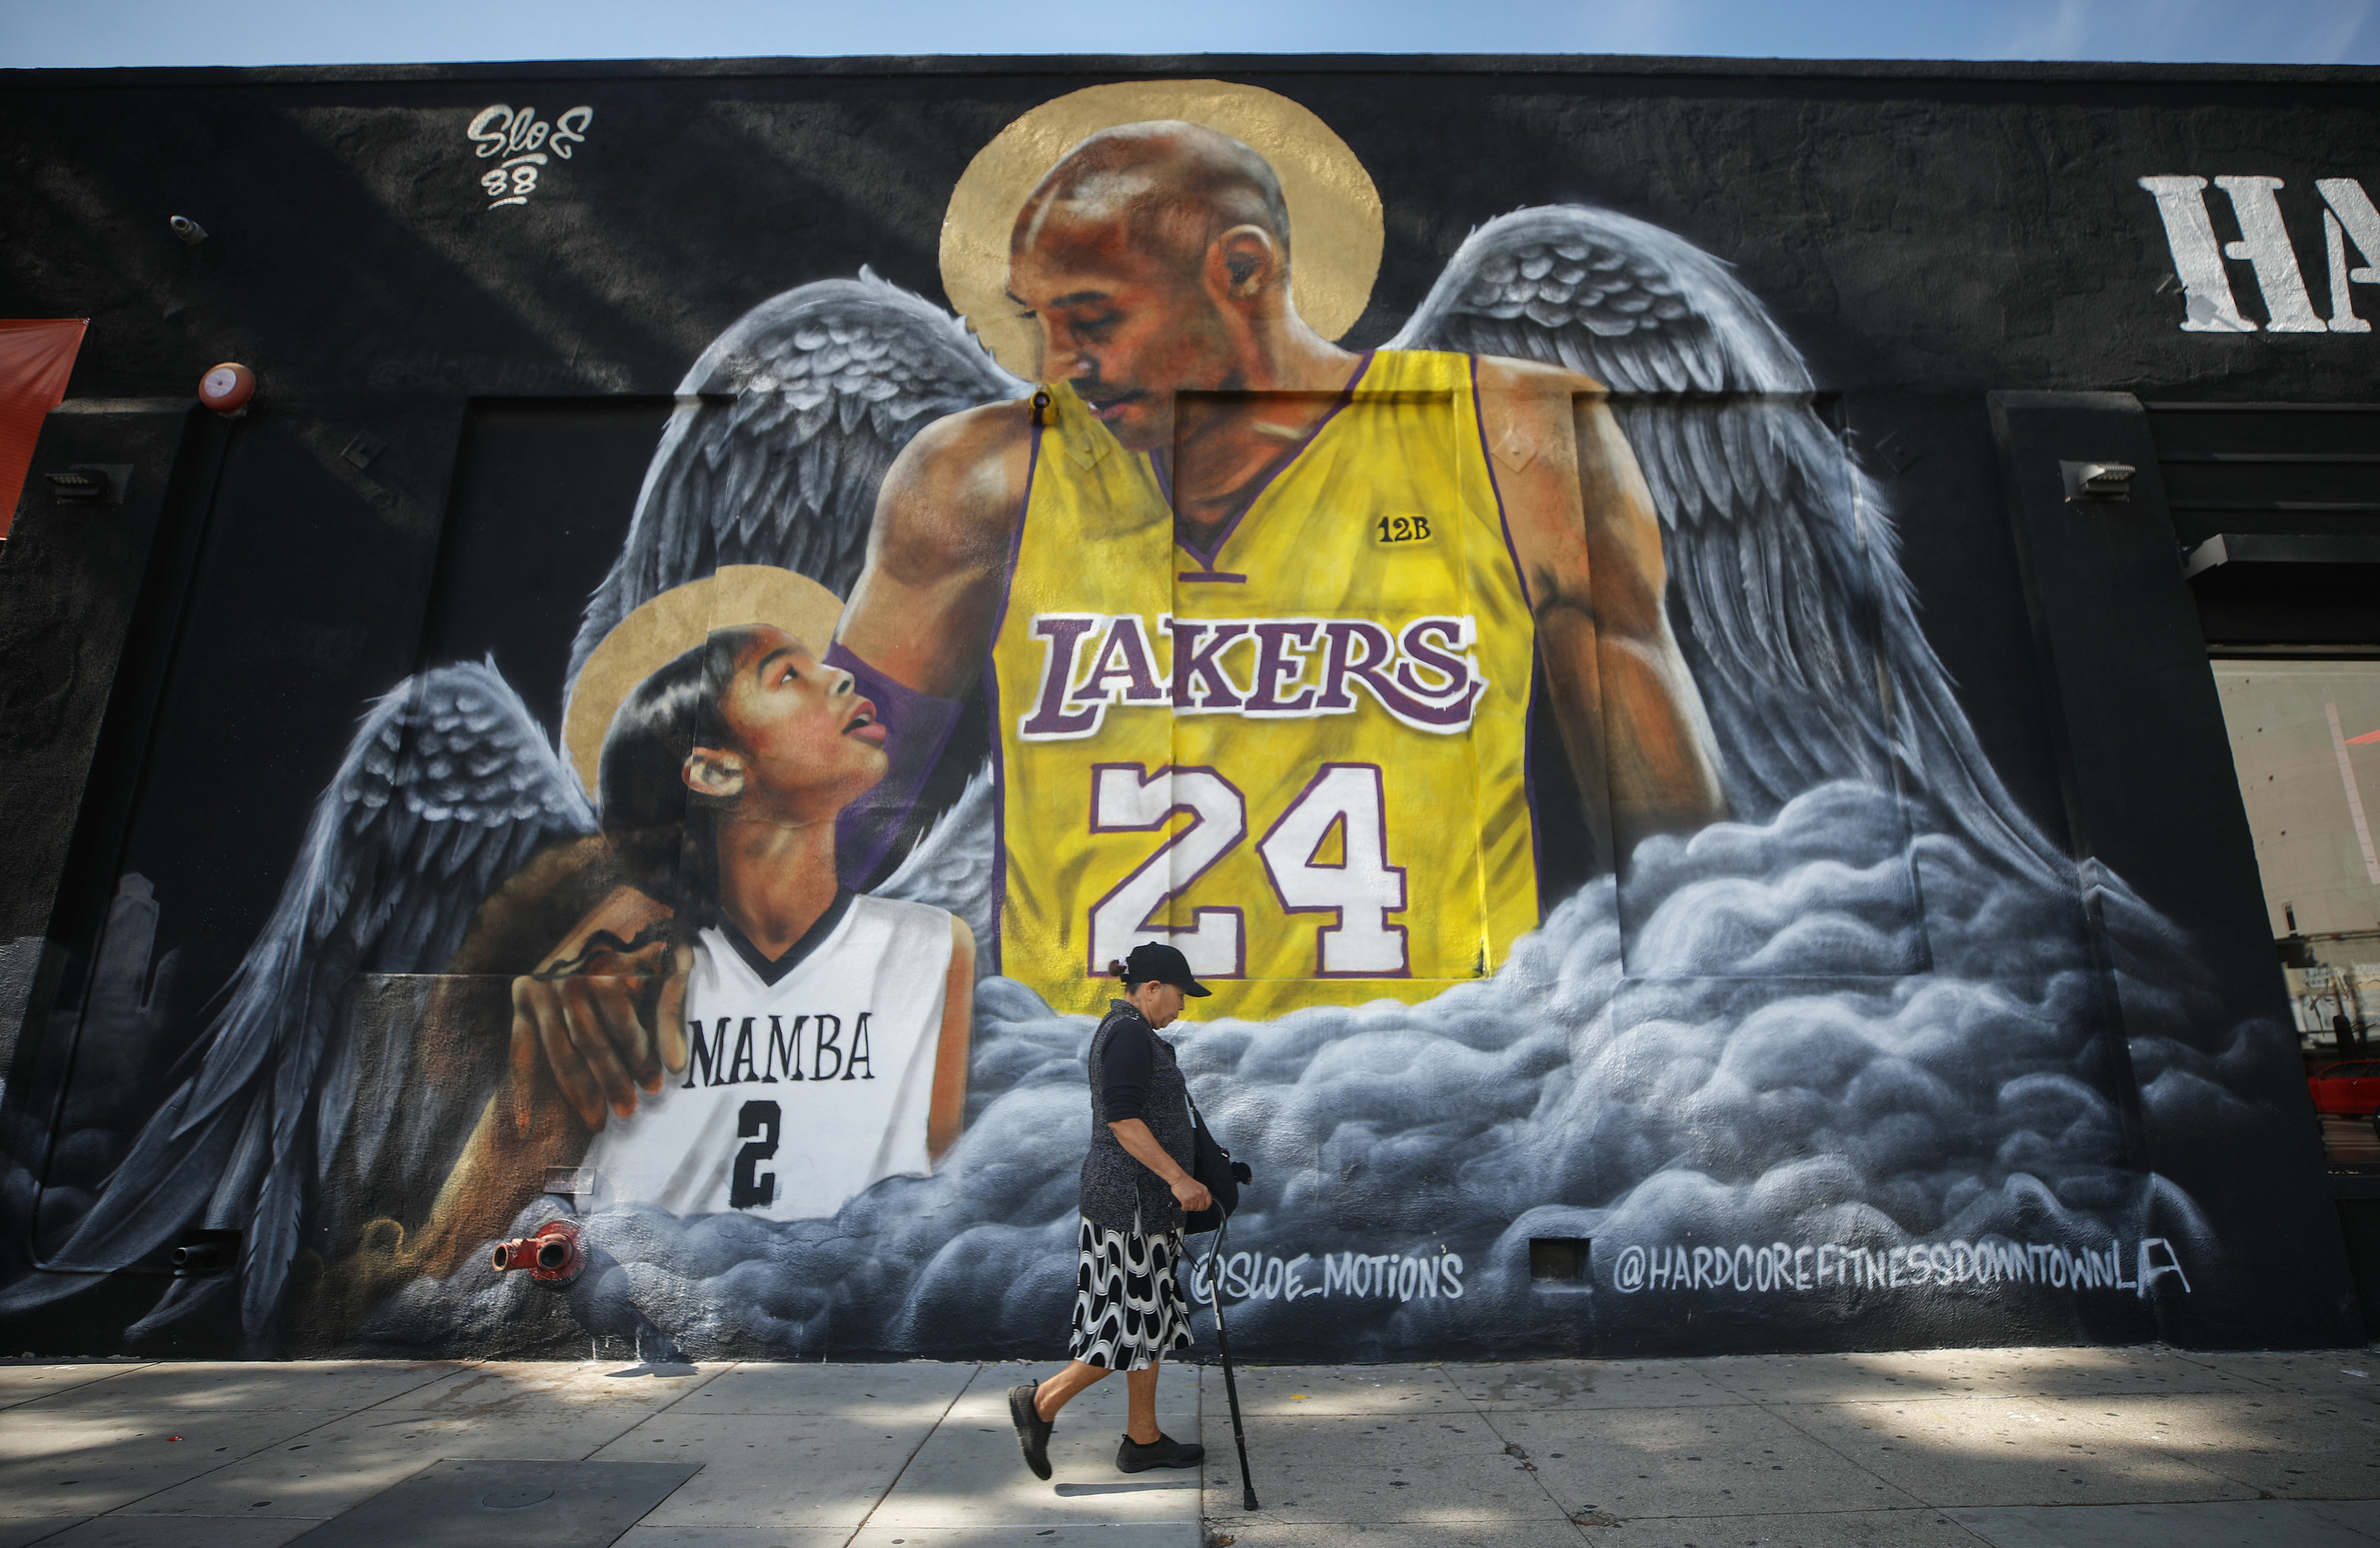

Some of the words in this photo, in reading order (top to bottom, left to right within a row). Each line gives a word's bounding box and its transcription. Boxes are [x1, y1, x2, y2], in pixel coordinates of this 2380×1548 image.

[481, 165, 538, 196] 88
[1376, 516, 1431, 544] 12B
[1017, 613, 1489, 742] LAKERS
[1088, 762, 1412, 979] 24
[681, 1012, 876, 1089] MAMBA
[730, 1100, 781, 1209] 2
